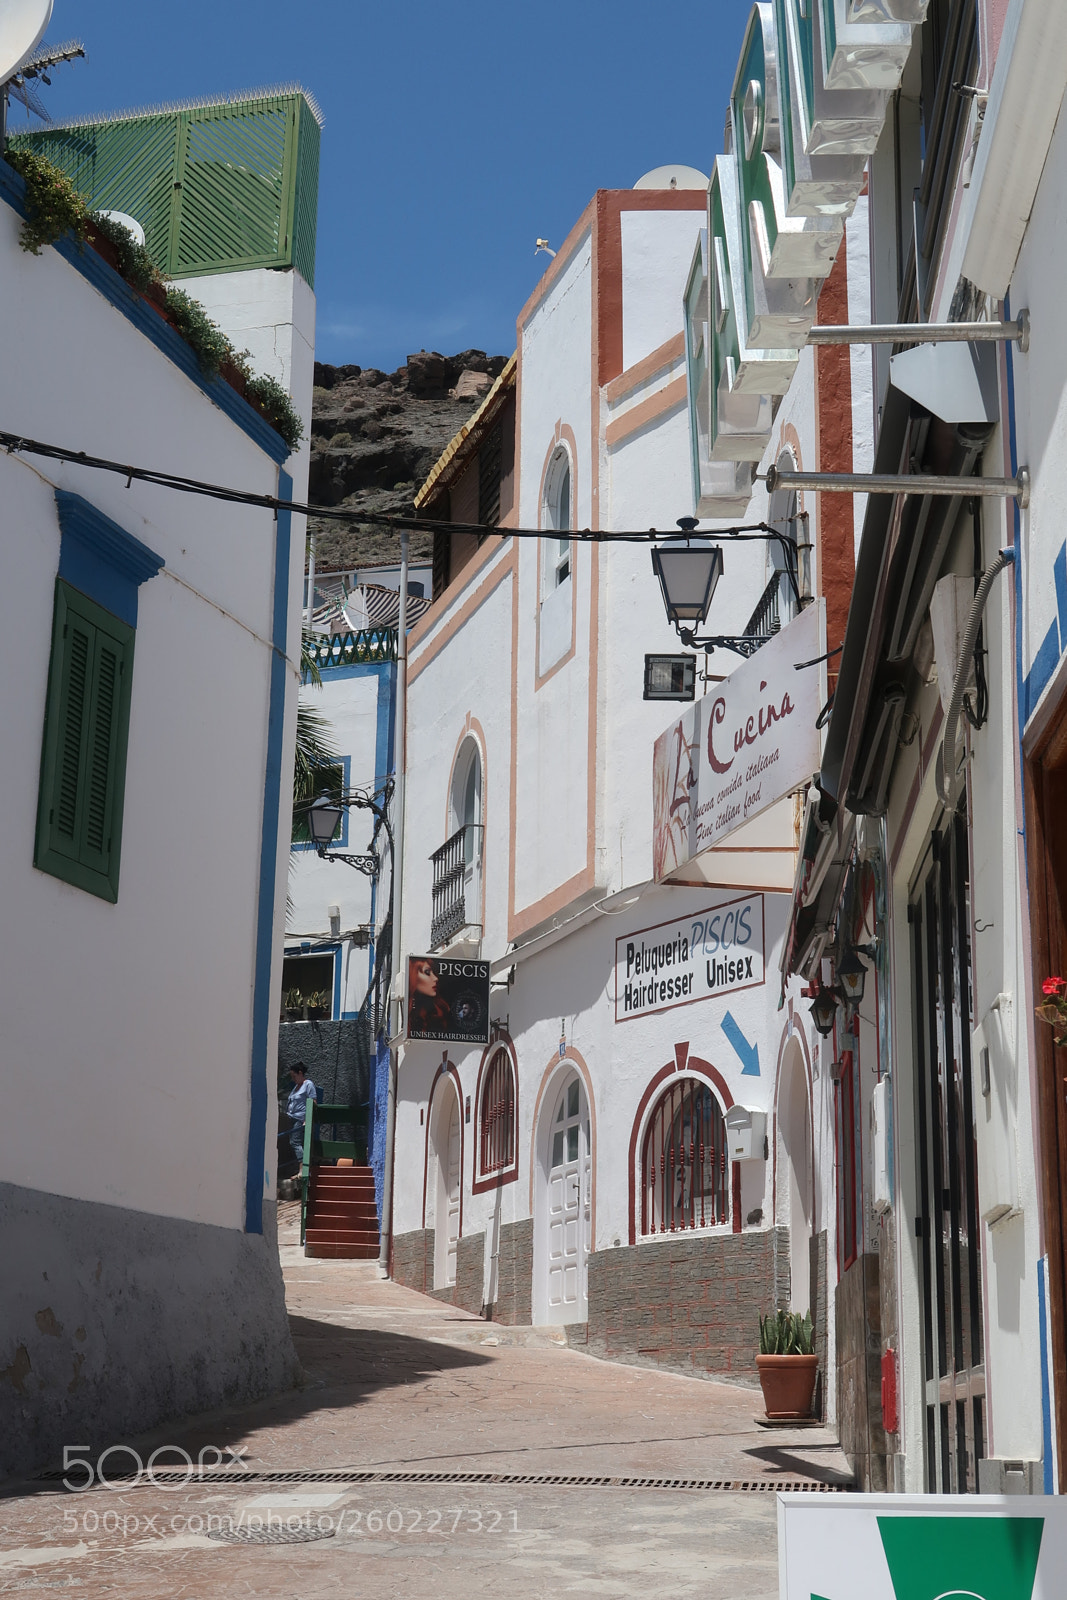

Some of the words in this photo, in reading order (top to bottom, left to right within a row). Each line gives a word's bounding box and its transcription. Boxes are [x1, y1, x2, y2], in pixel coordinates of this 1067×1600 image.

[670, 720, 698, 817] La
[707, 680, 795, 775] Cucina
[692, 795, 715, 823] buena
[716, 771, 743, 805] comida
[745, 747, 780, 782] italiana
[695, 822, 713, 848] Fine
[714, 800, 742, 836] italian
[743, 782, 762, 818] food
[689, 905, 752, 958] PISCIS
[438, 962, 488, 978] PISCIS
[624, 971, 694, 1011] Hairdresser
[706, 955, 753, 988] Unisex
[410, 1030, 437, 1039] UNISEX
[438, 1032, 487, 1041] HAIRDRESSER
